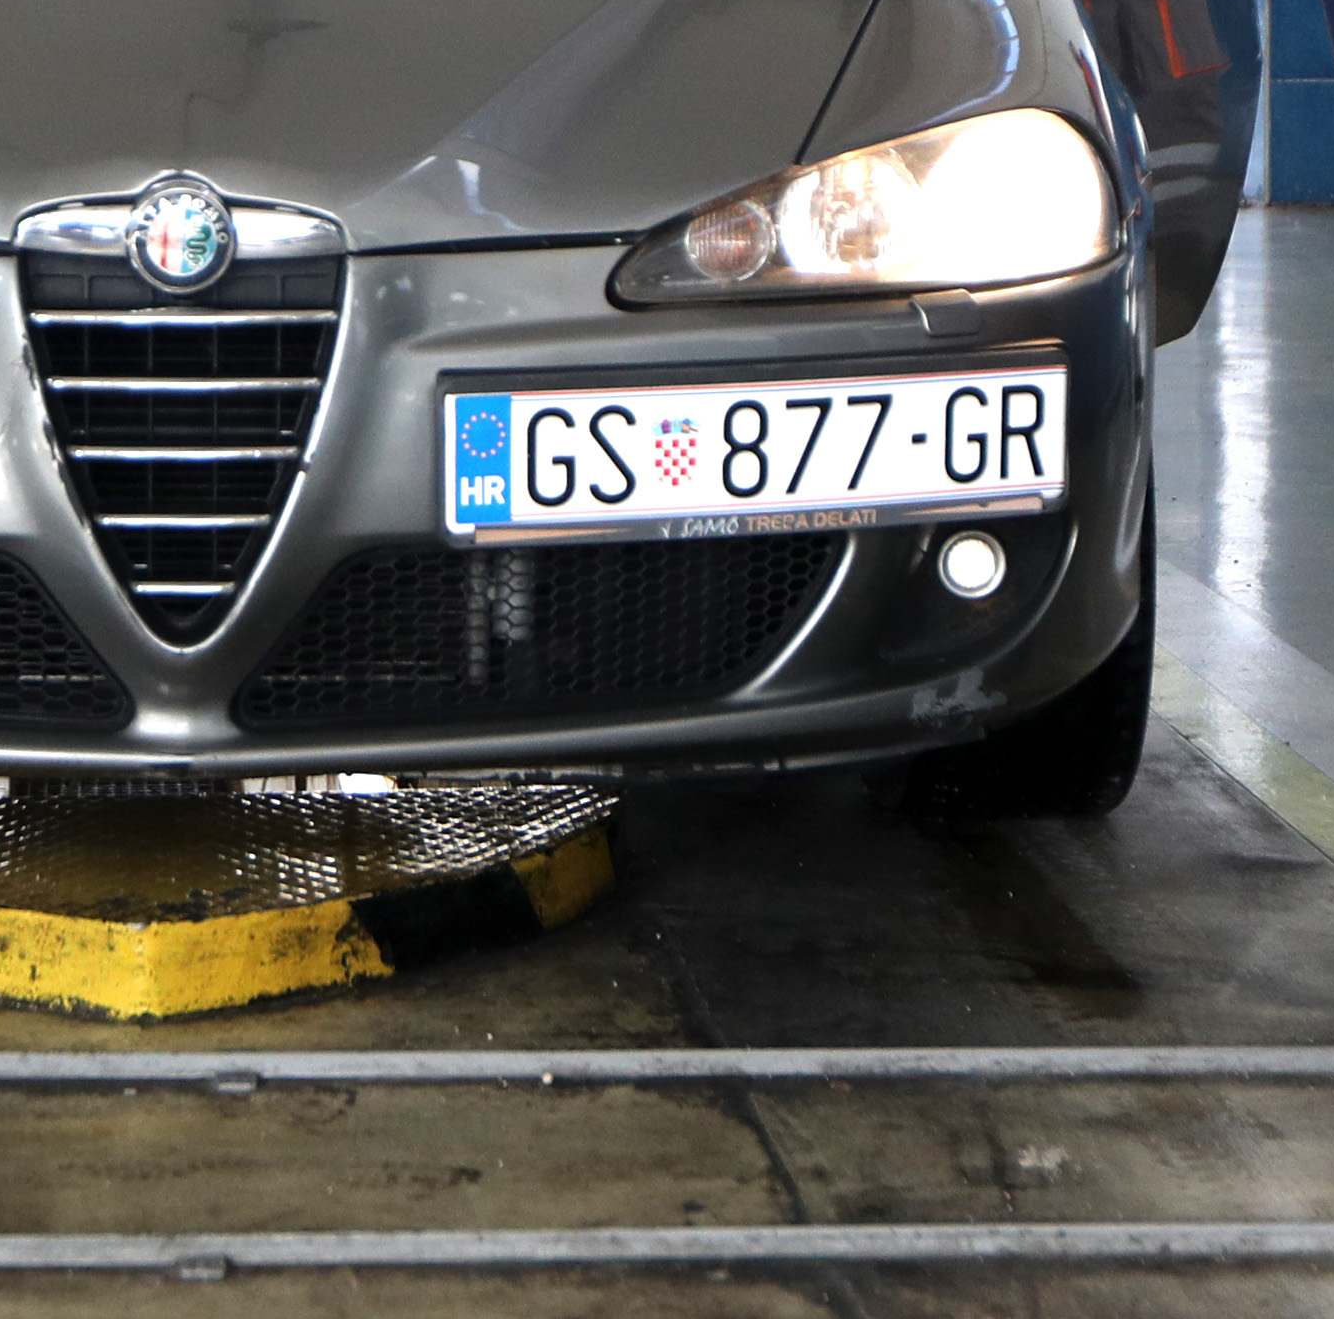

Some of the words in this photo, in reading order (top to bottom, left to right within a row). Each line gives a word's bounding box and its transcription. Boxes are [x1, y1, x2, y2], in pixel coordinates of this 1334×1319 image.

[526, 405, 636, 507] GS
[461, 475, 506, 506] HR
[681, 515, 739, 538] SAMO
[814, 508, 877, 528] DELATI
